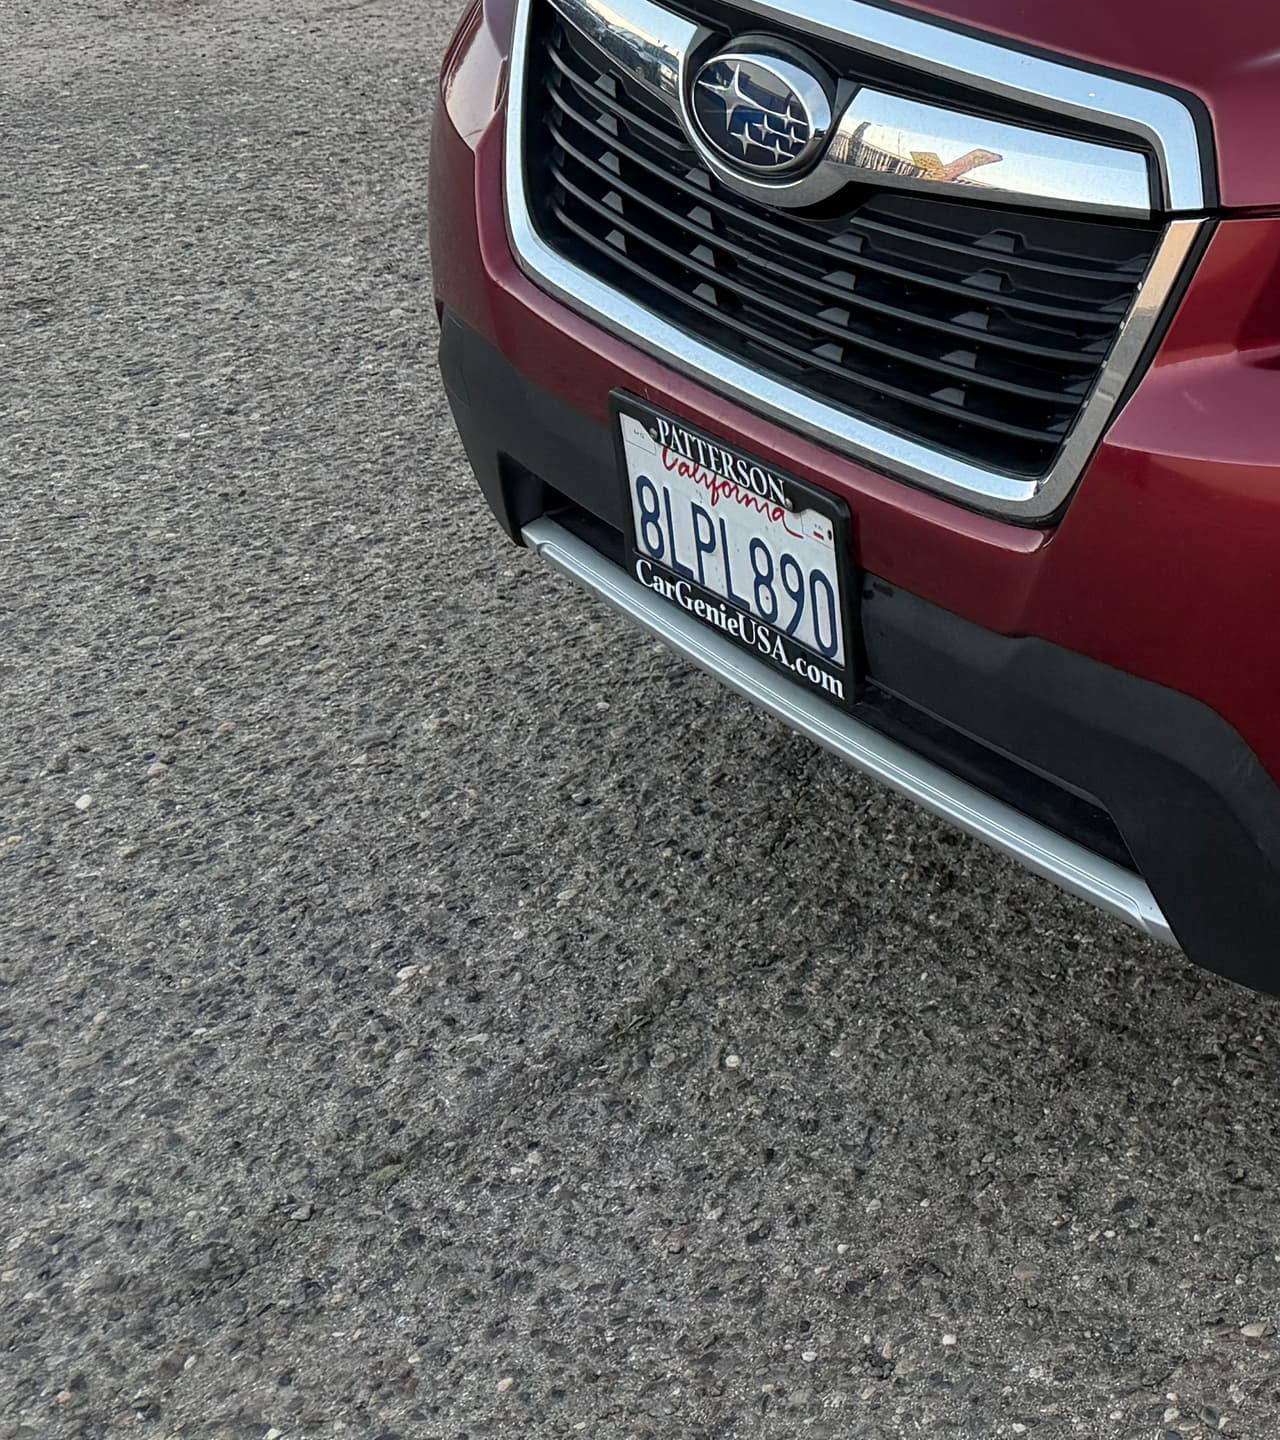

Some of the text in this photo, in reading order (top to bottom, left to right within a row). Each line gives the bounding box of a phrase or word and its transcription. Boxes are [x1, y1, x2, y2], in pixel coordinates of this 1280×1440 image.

[656, 416, 786, 507] PATTERSON
[635, 474, 839, 660] 8LPL890
[635, 557, 847, 701] CarGenieUSA.com
